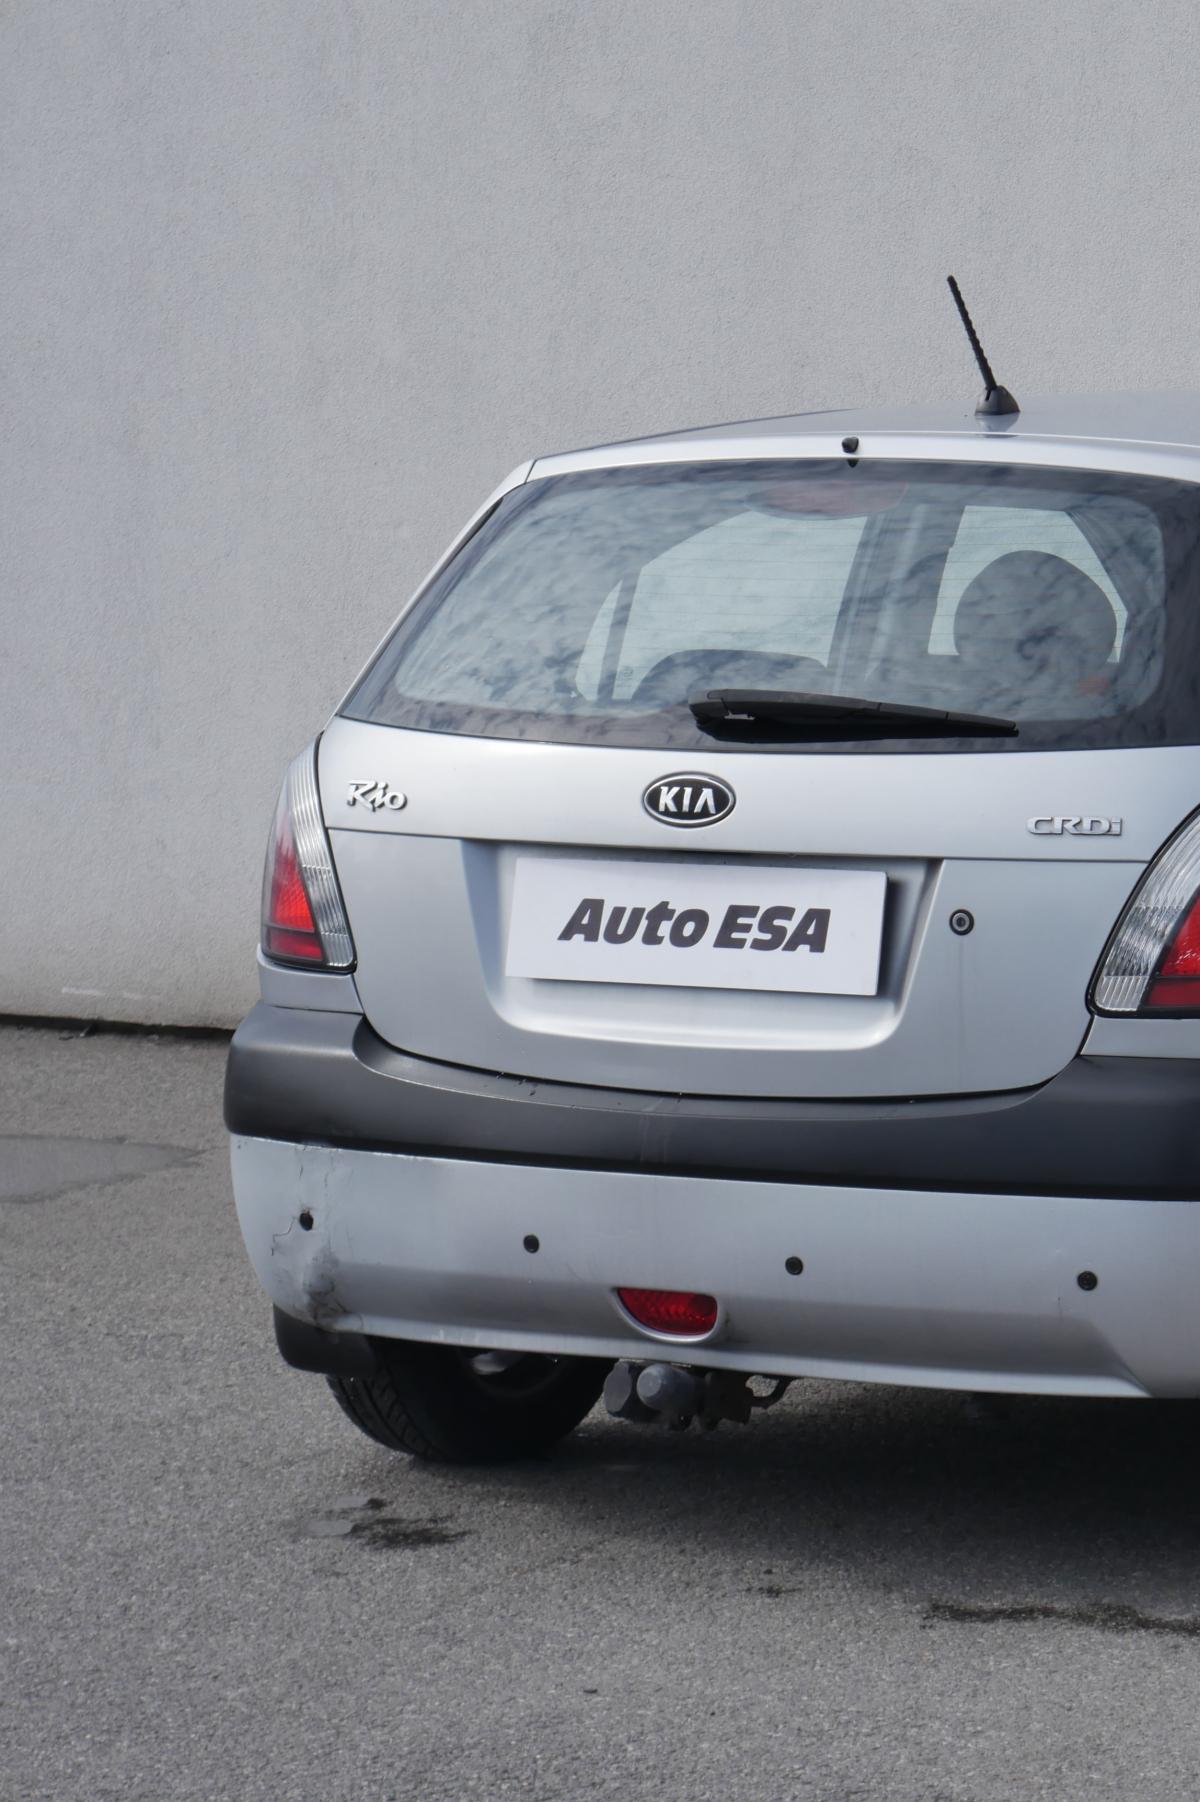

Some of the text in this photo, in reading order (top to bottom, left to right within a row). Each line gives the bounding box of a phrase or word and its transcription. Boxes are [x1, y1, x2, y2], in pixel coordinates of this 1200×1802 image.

[347, 780, 408, 812] Rio
[658, 785, 716, 814] KIA
[1026, 816, 1122, 836] CRDi
[557, 898, 832, 953] Auto ESA
